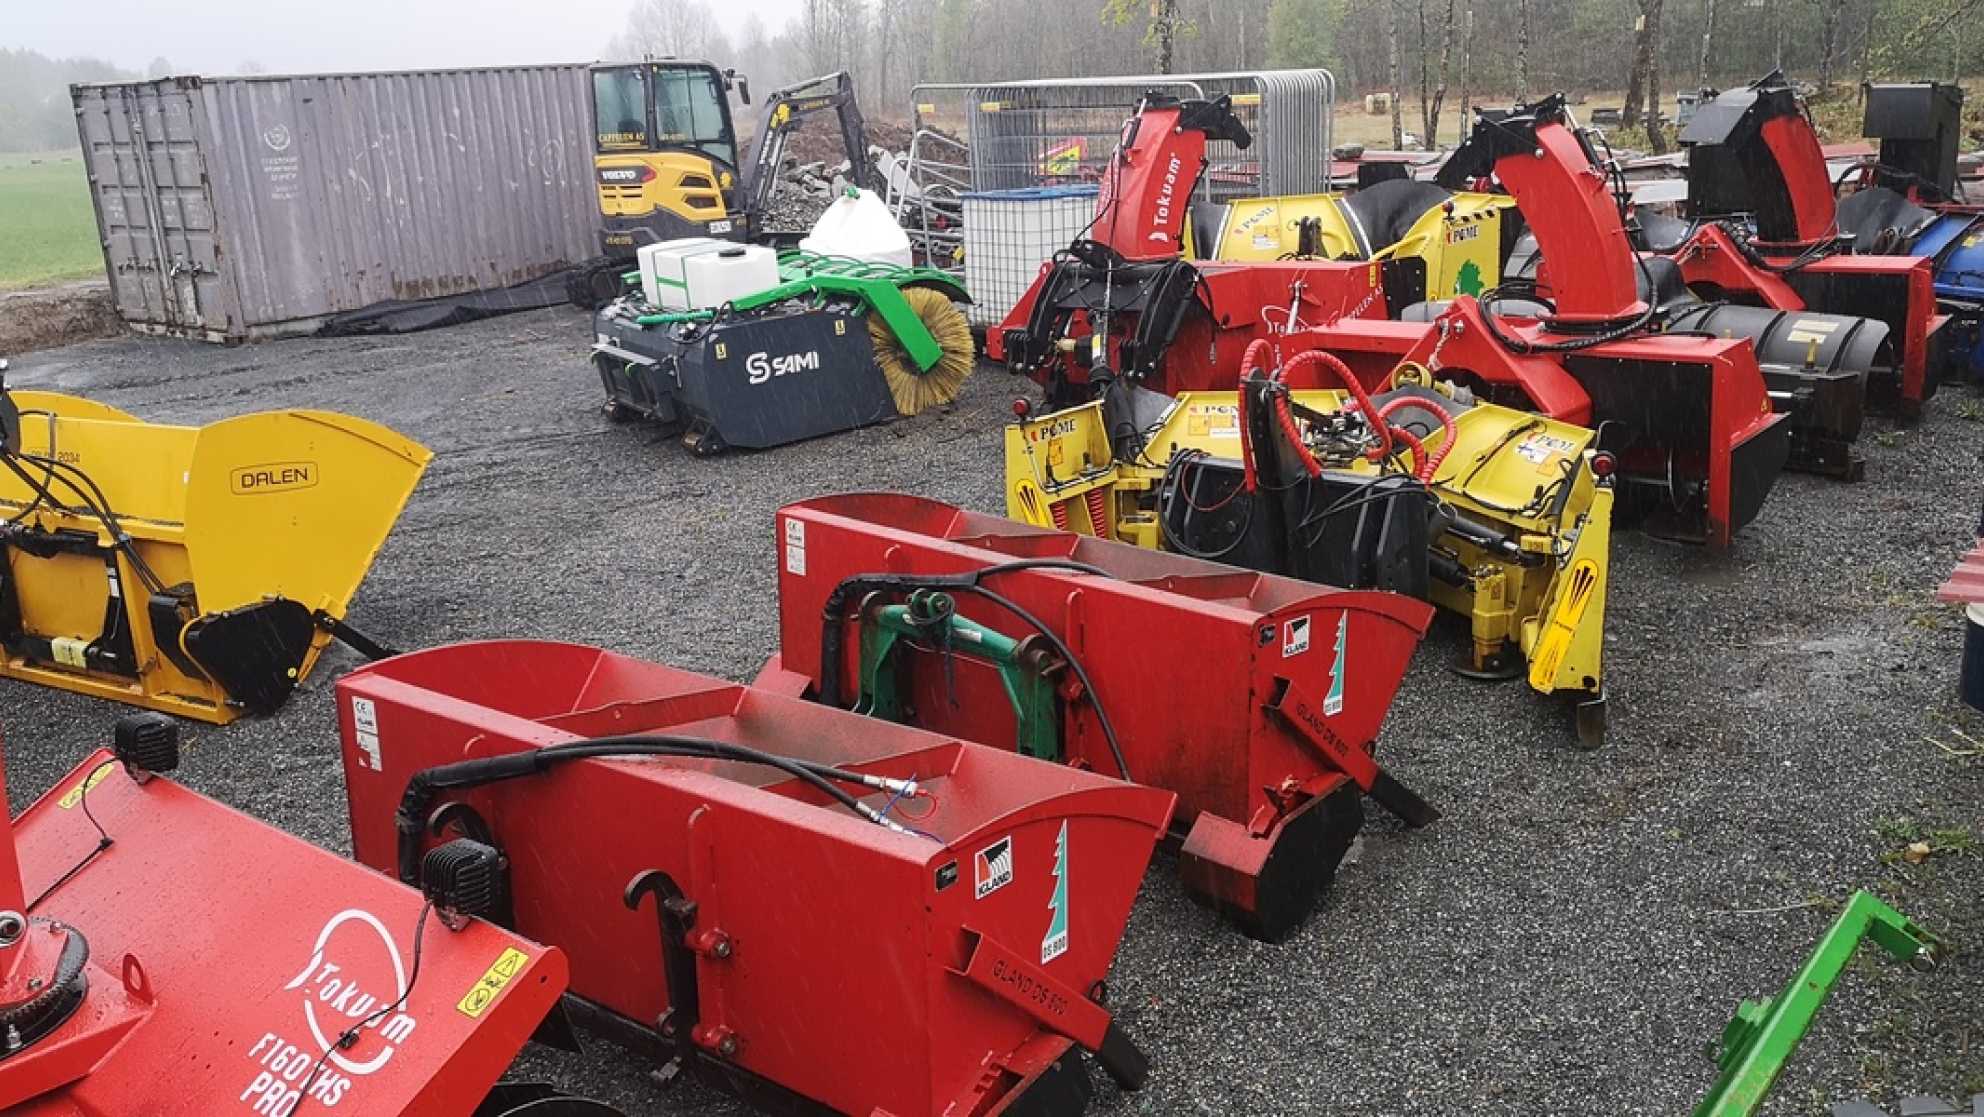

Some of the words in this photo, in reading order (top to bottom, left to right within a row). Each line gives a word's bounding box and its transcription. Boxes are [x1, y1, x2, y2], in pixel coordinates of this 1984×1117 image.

[772, 351, 820, 377] SAMI
[240, 467, 309, 489] DALEN
[239, 1071, 301, 1117] PRO
